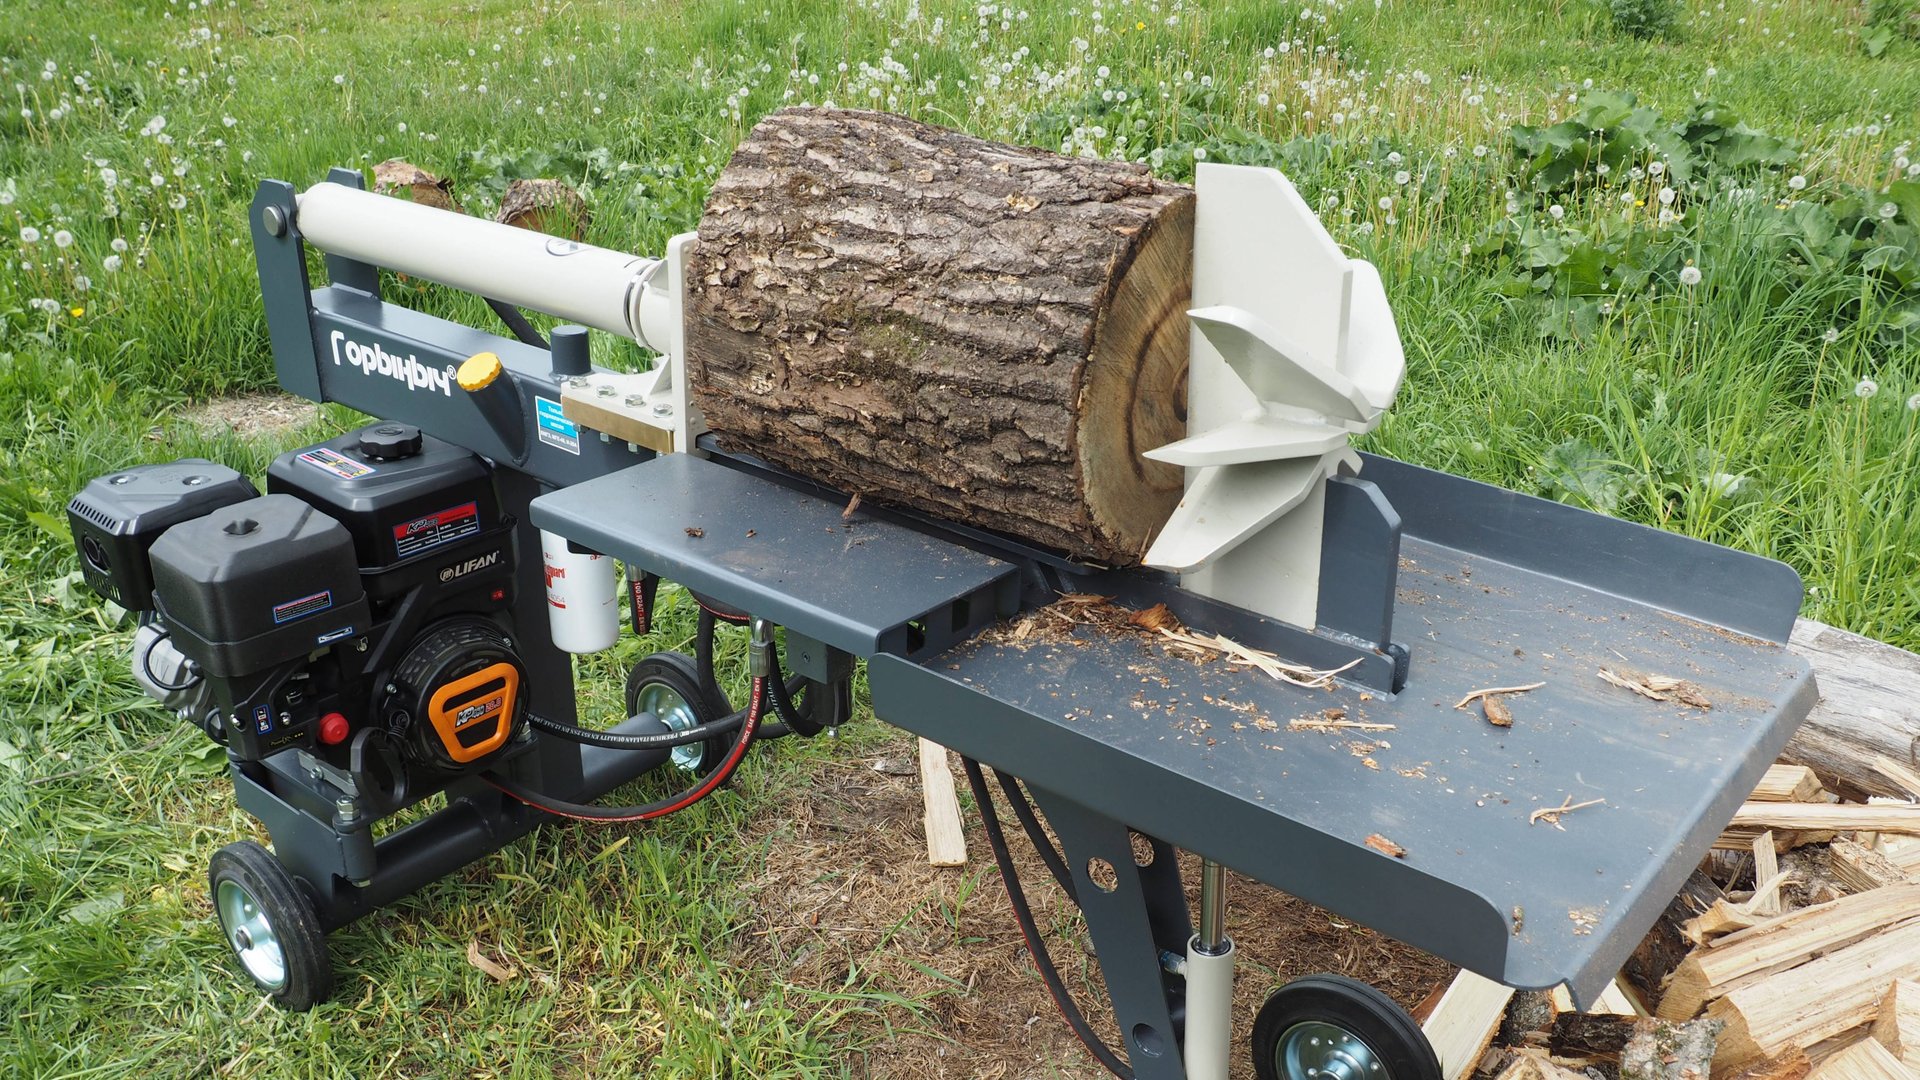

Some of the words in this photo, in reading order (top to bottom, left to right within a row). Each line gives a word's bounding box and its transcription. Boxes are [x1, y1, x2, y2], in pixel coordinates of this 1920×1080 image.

[455, 552, 497, 577] LIFAN
[747, 719, 755, 729] SAE
[650, 733, 678, 742] PREMIUM
